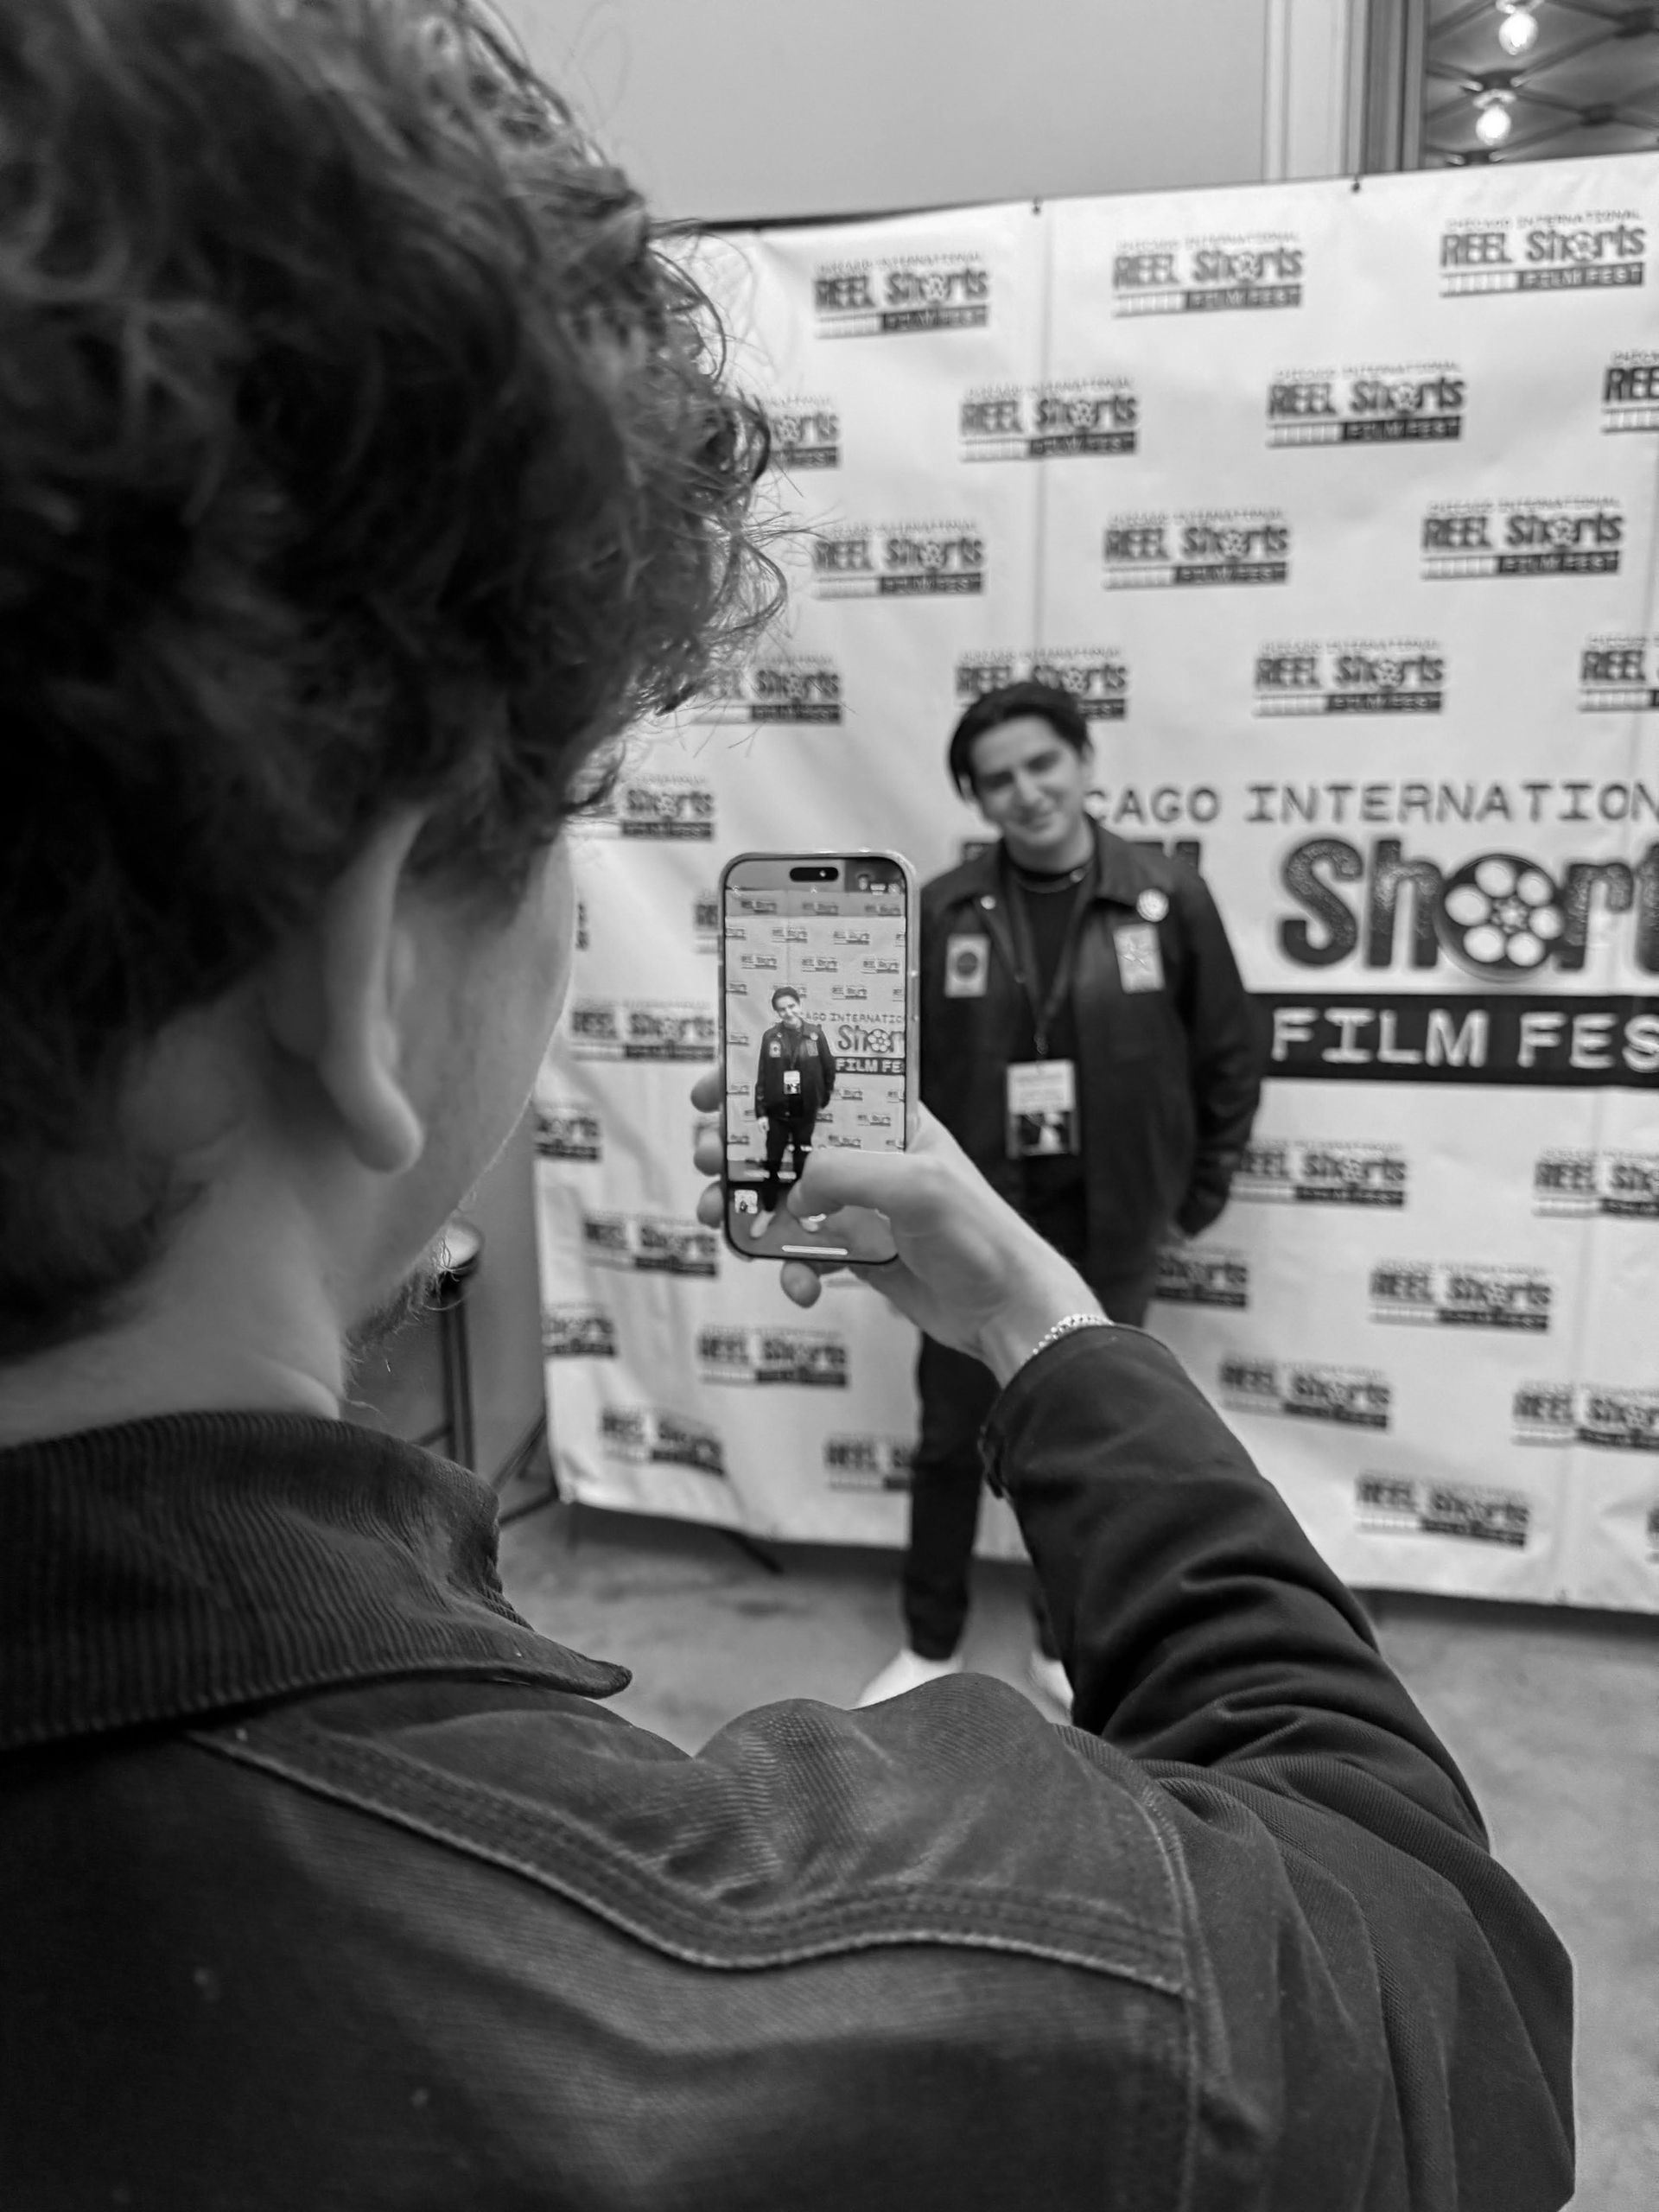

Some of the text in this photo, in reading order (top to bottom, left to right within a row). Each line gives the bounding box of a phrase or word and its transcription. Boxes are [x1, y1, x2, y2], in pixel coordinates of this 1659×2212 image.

[1441, 232, 1512, 267] REEL
[1271, 1007, 1490, 1069] FILM
[835, 1058, 878, 1072] FILM
